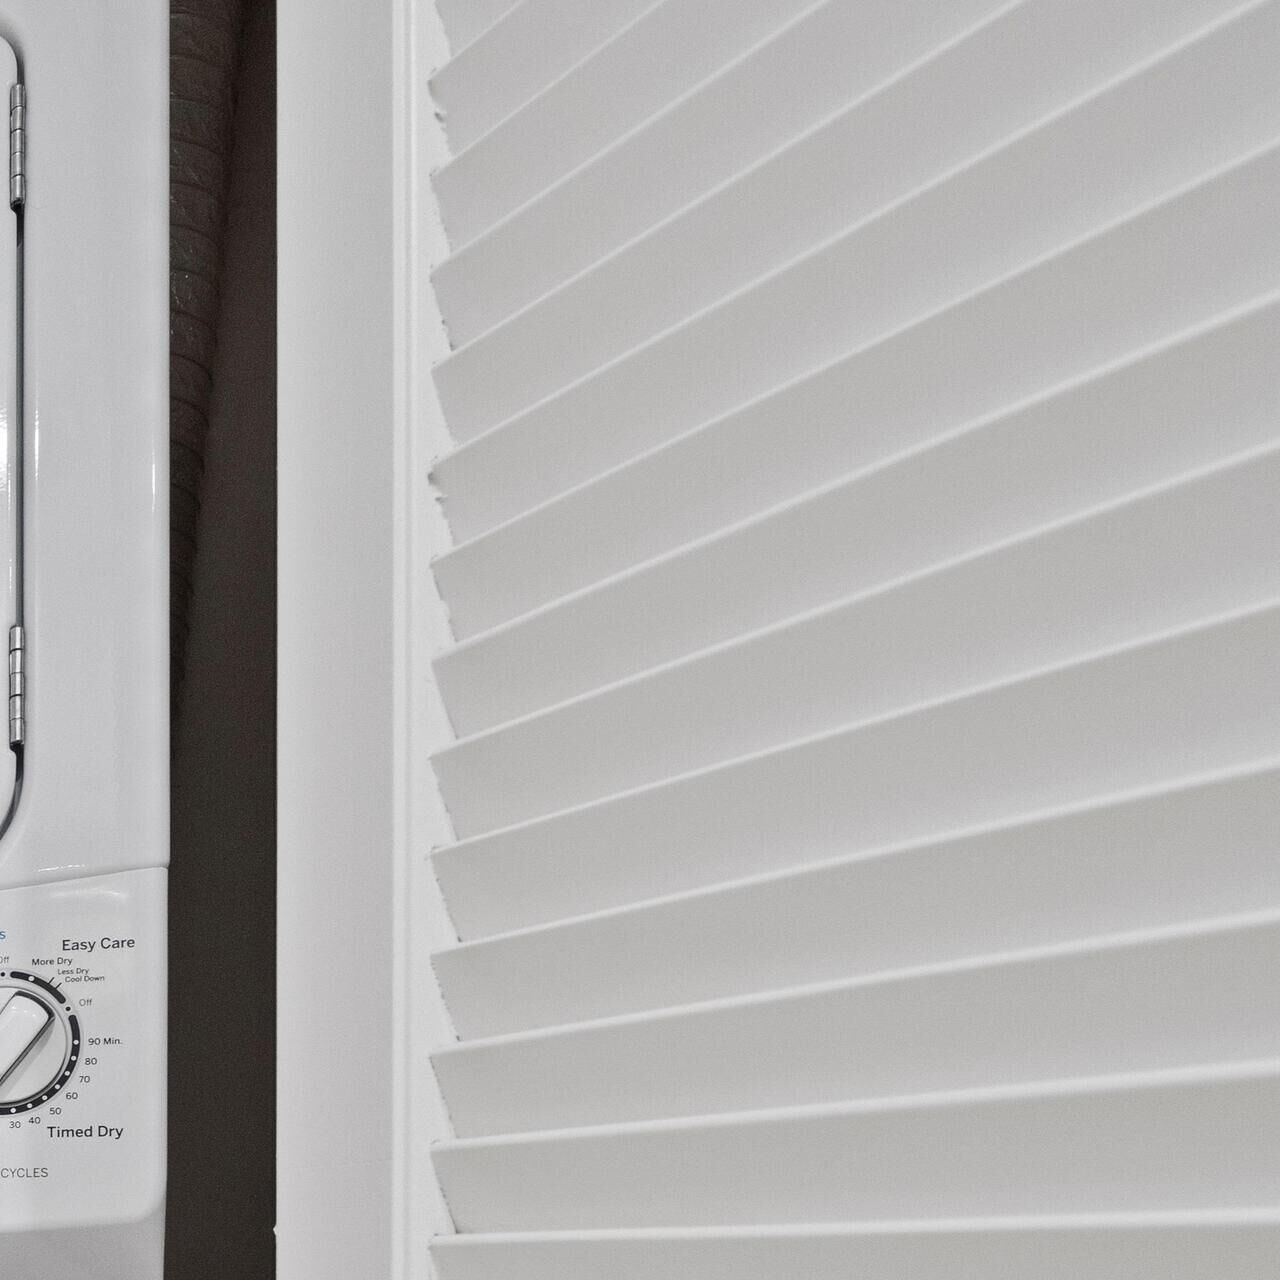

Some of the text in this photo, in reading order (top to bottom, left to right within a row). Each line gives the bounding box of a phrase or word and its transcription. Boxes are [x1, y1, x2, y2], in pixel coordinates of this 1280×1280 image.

[62, 938, 135, 952] Easy Care
[57, 957, 72, 965] Dry
[104, 1037, 123, 1045] Min.
[9, 1121, 21, 1129] 30
[47, 1126, 123, 1139] Timed Dry
[1, 1168, 49, 1179] CYCLES
